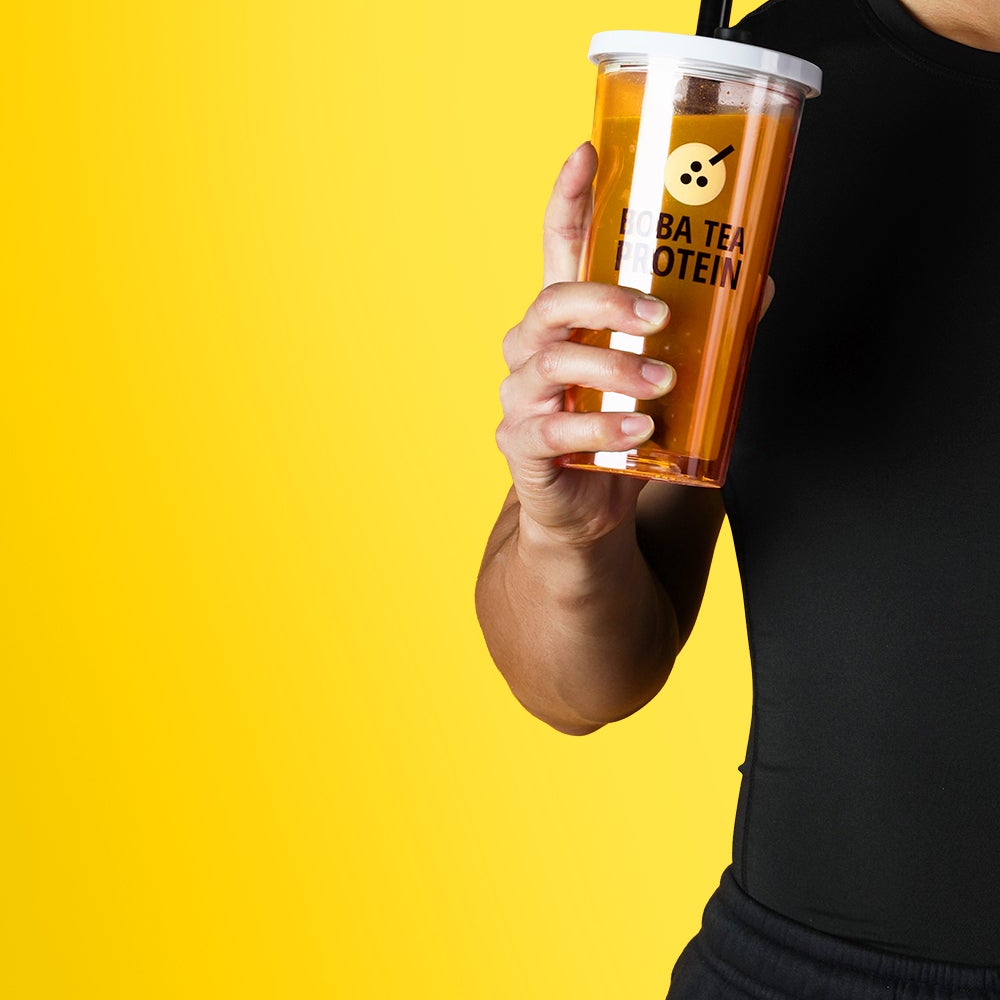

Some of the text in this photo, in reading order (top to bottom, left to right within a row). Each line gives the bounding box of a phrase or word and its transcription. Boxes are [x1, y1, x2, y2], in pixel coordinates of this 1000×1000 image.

[620, 208, 744, 254] BOBA TEA
[614, 240, 742, 290] PROTEIN
